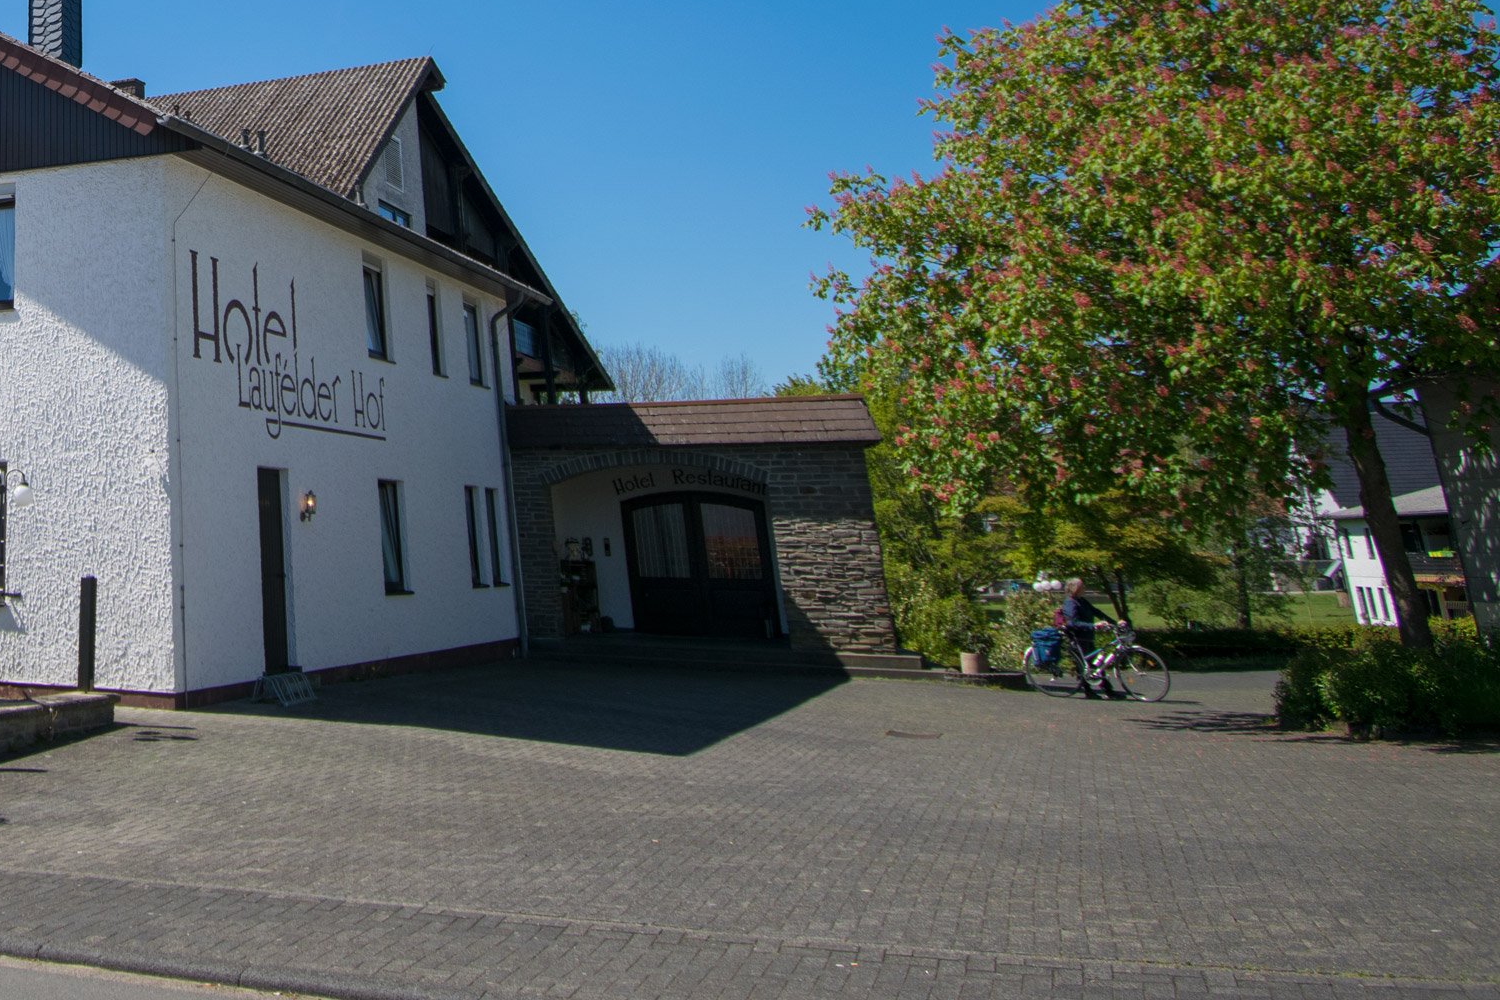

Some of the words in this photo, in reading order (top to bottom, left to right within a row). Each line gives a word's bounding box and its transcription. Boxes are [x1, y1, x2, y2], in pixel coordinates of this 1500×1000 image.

[189, 249, 298, 366] Hotel
[352, 370, 386, 431] Hof
[612, 471, 655, 495] Hotel
[672, 468, 768, 495] Restaurant
